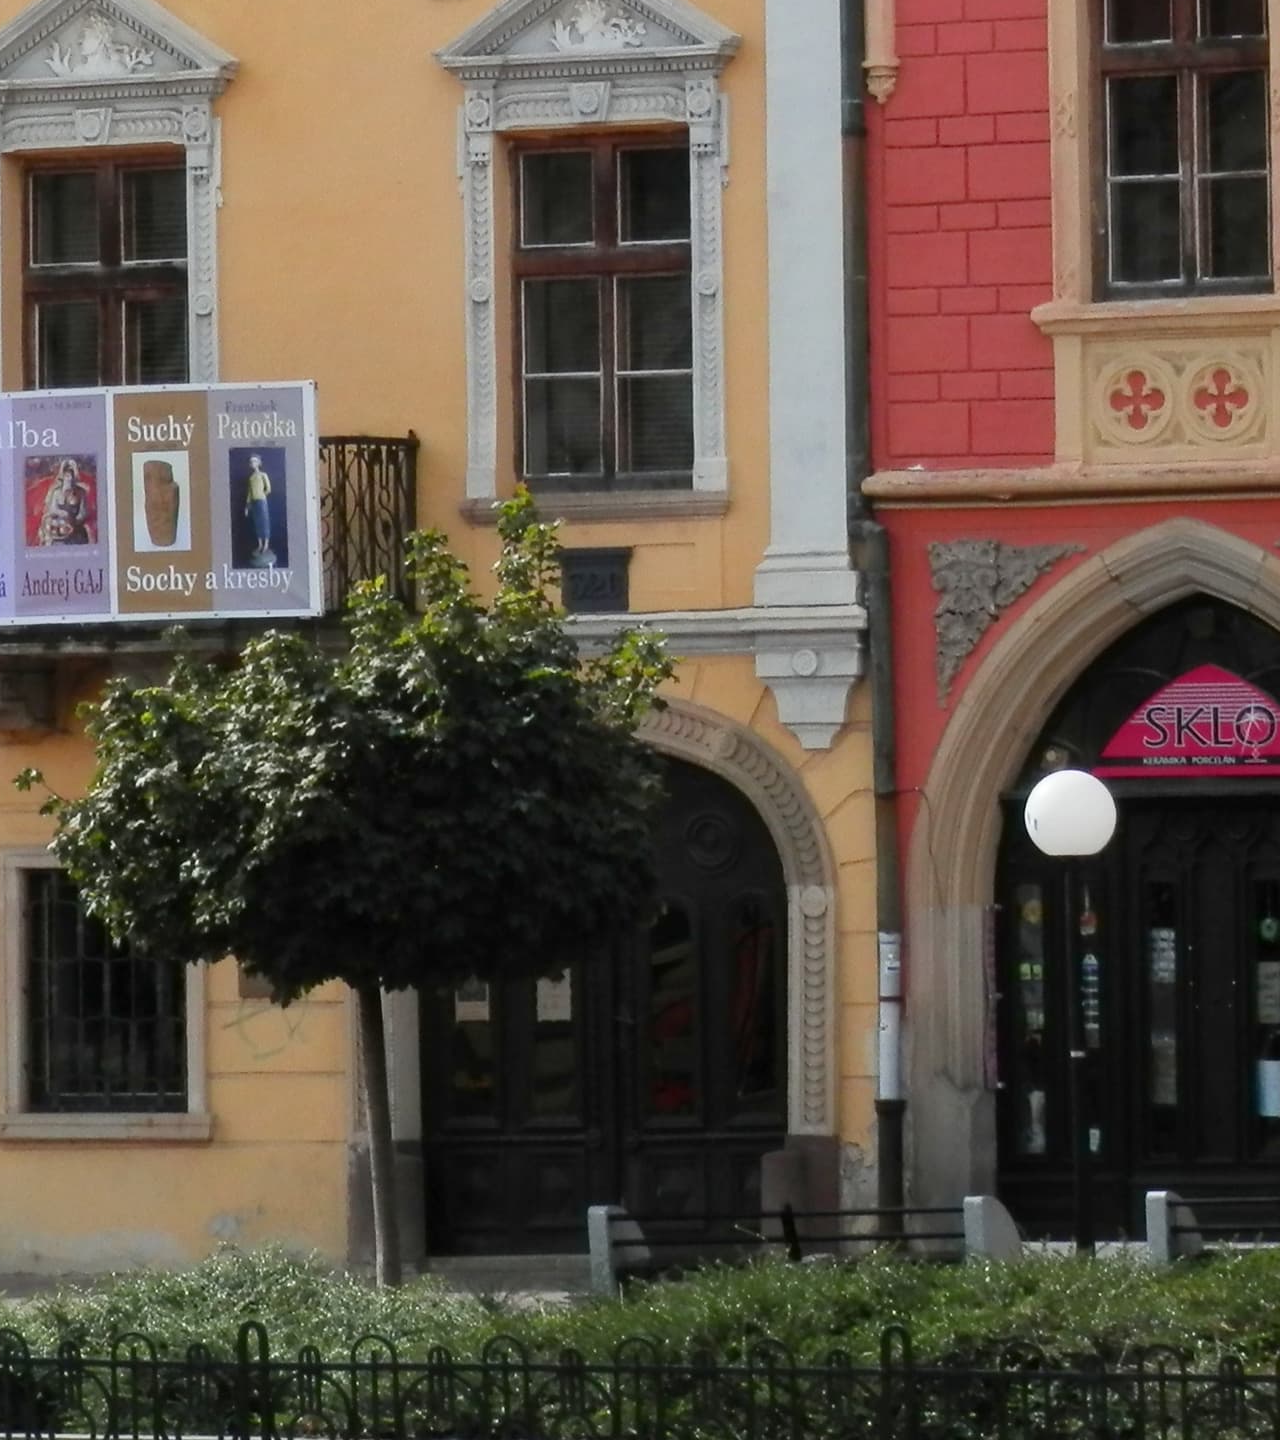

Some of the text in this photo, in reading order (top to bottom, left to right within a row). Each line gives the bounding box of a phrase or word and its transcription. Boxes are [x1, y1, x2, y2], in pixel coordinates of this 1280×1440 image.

[127, 414, 195, 447] Suchý
[217, 411, 297, 440] Patočka
[22, 568, 104, 601] Andrej GAJ
[126, 562, 294, 597] Sochy a kresby
[1142, 703, 1279, 748] SKLO
